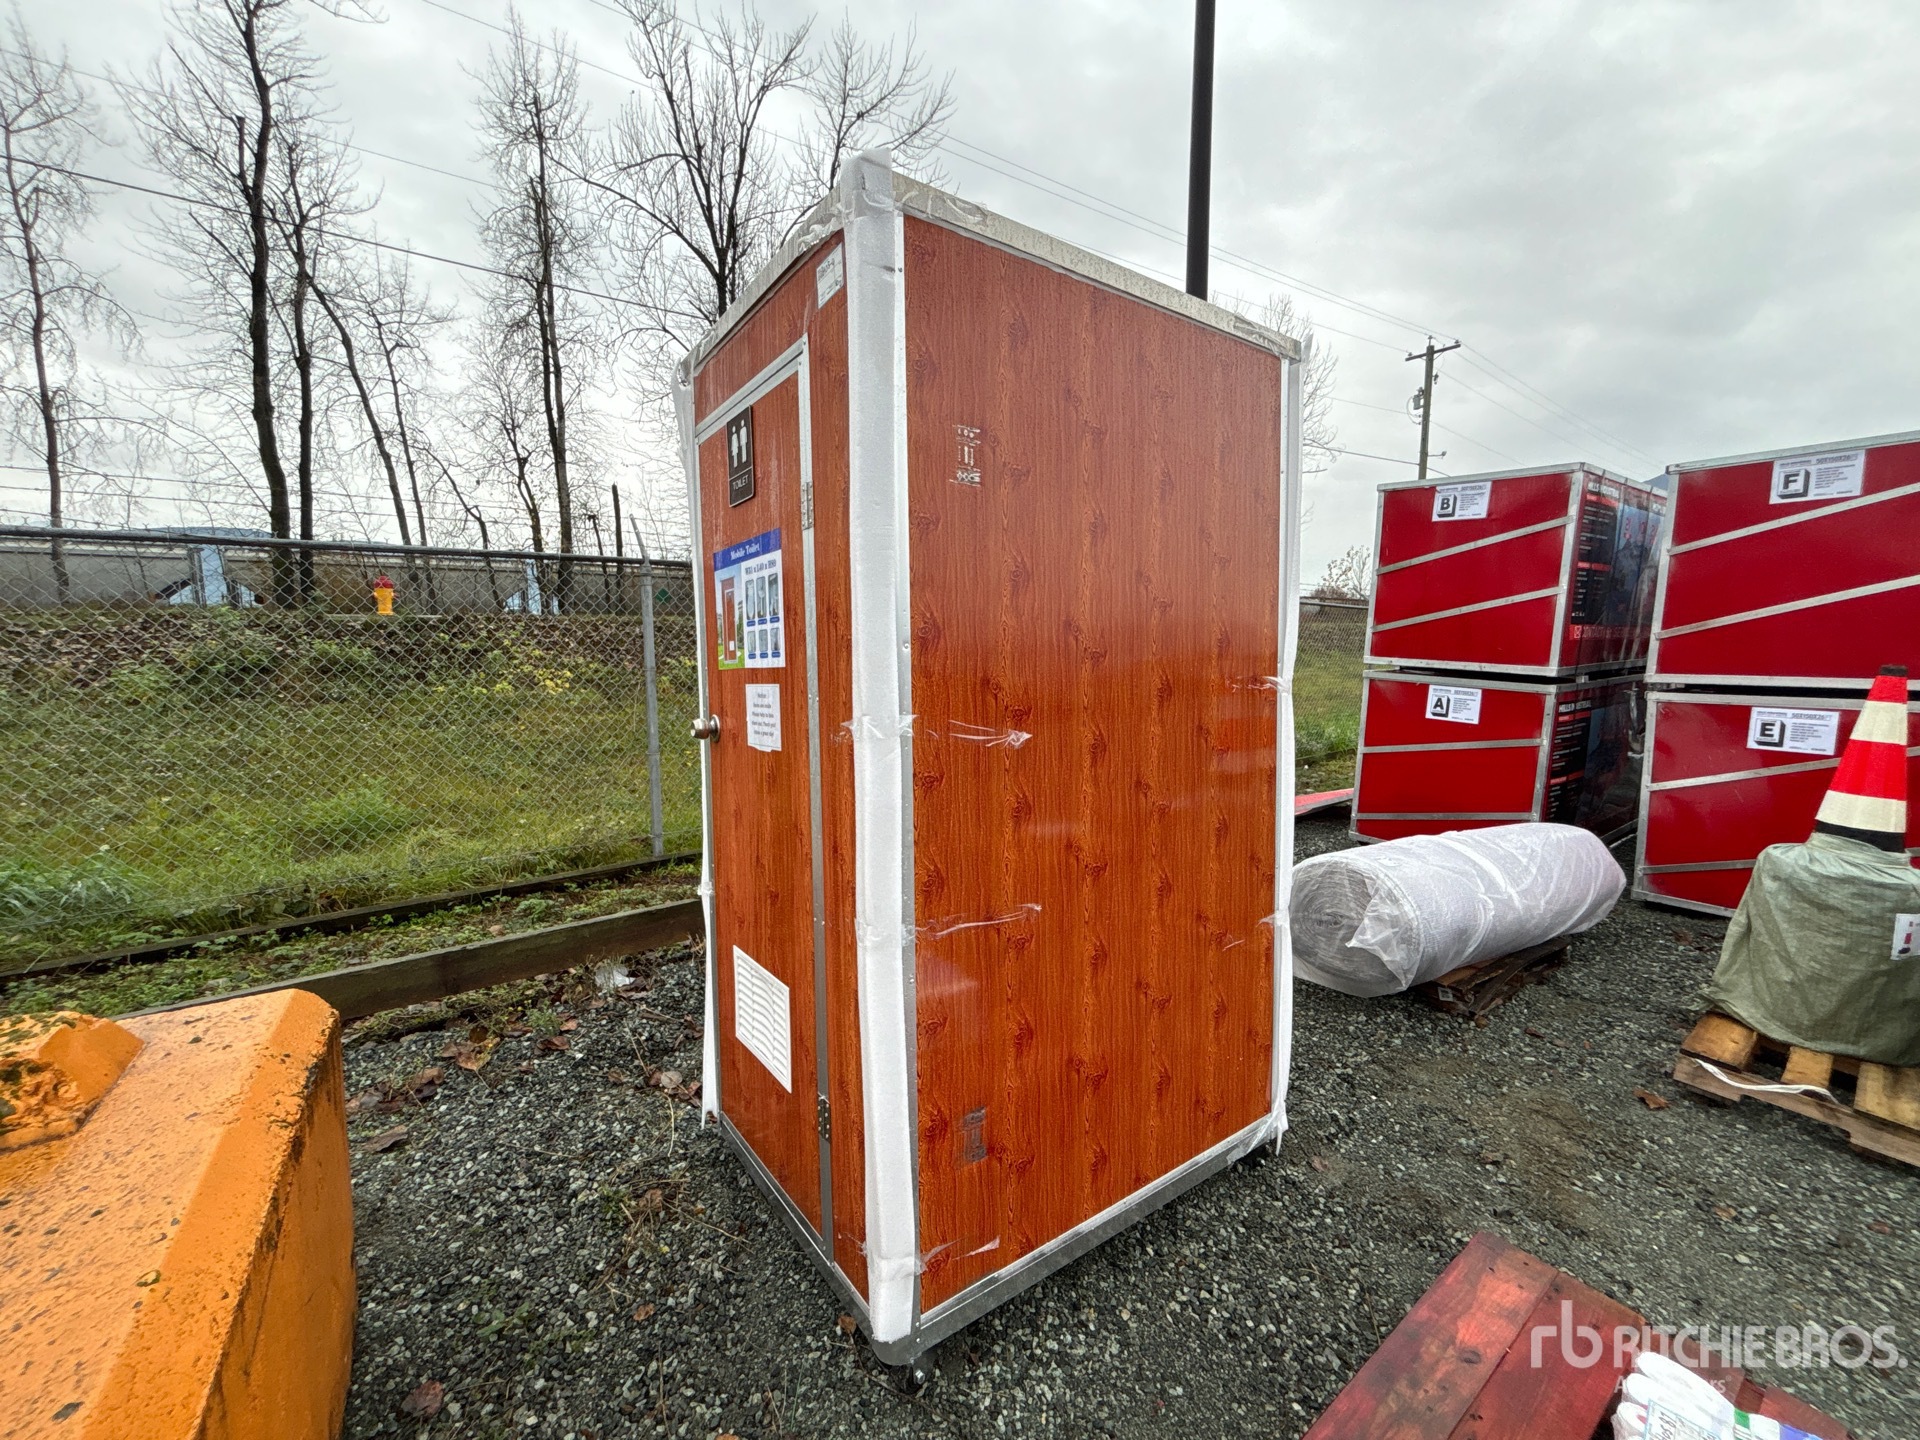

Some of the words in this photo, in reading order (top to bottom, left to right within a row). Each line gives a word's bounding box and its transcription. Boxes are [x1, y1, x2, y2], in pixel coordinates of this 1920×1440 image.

[733, 475, 748, 490] TOILET
[1782, 473, 1800, 490] F
[1440, 497, 1451, 511] B
[746, 543, 760, 554] Toilet
[1433, 697, 1444, 710] A
[1760, 722, 1775, 738] E
